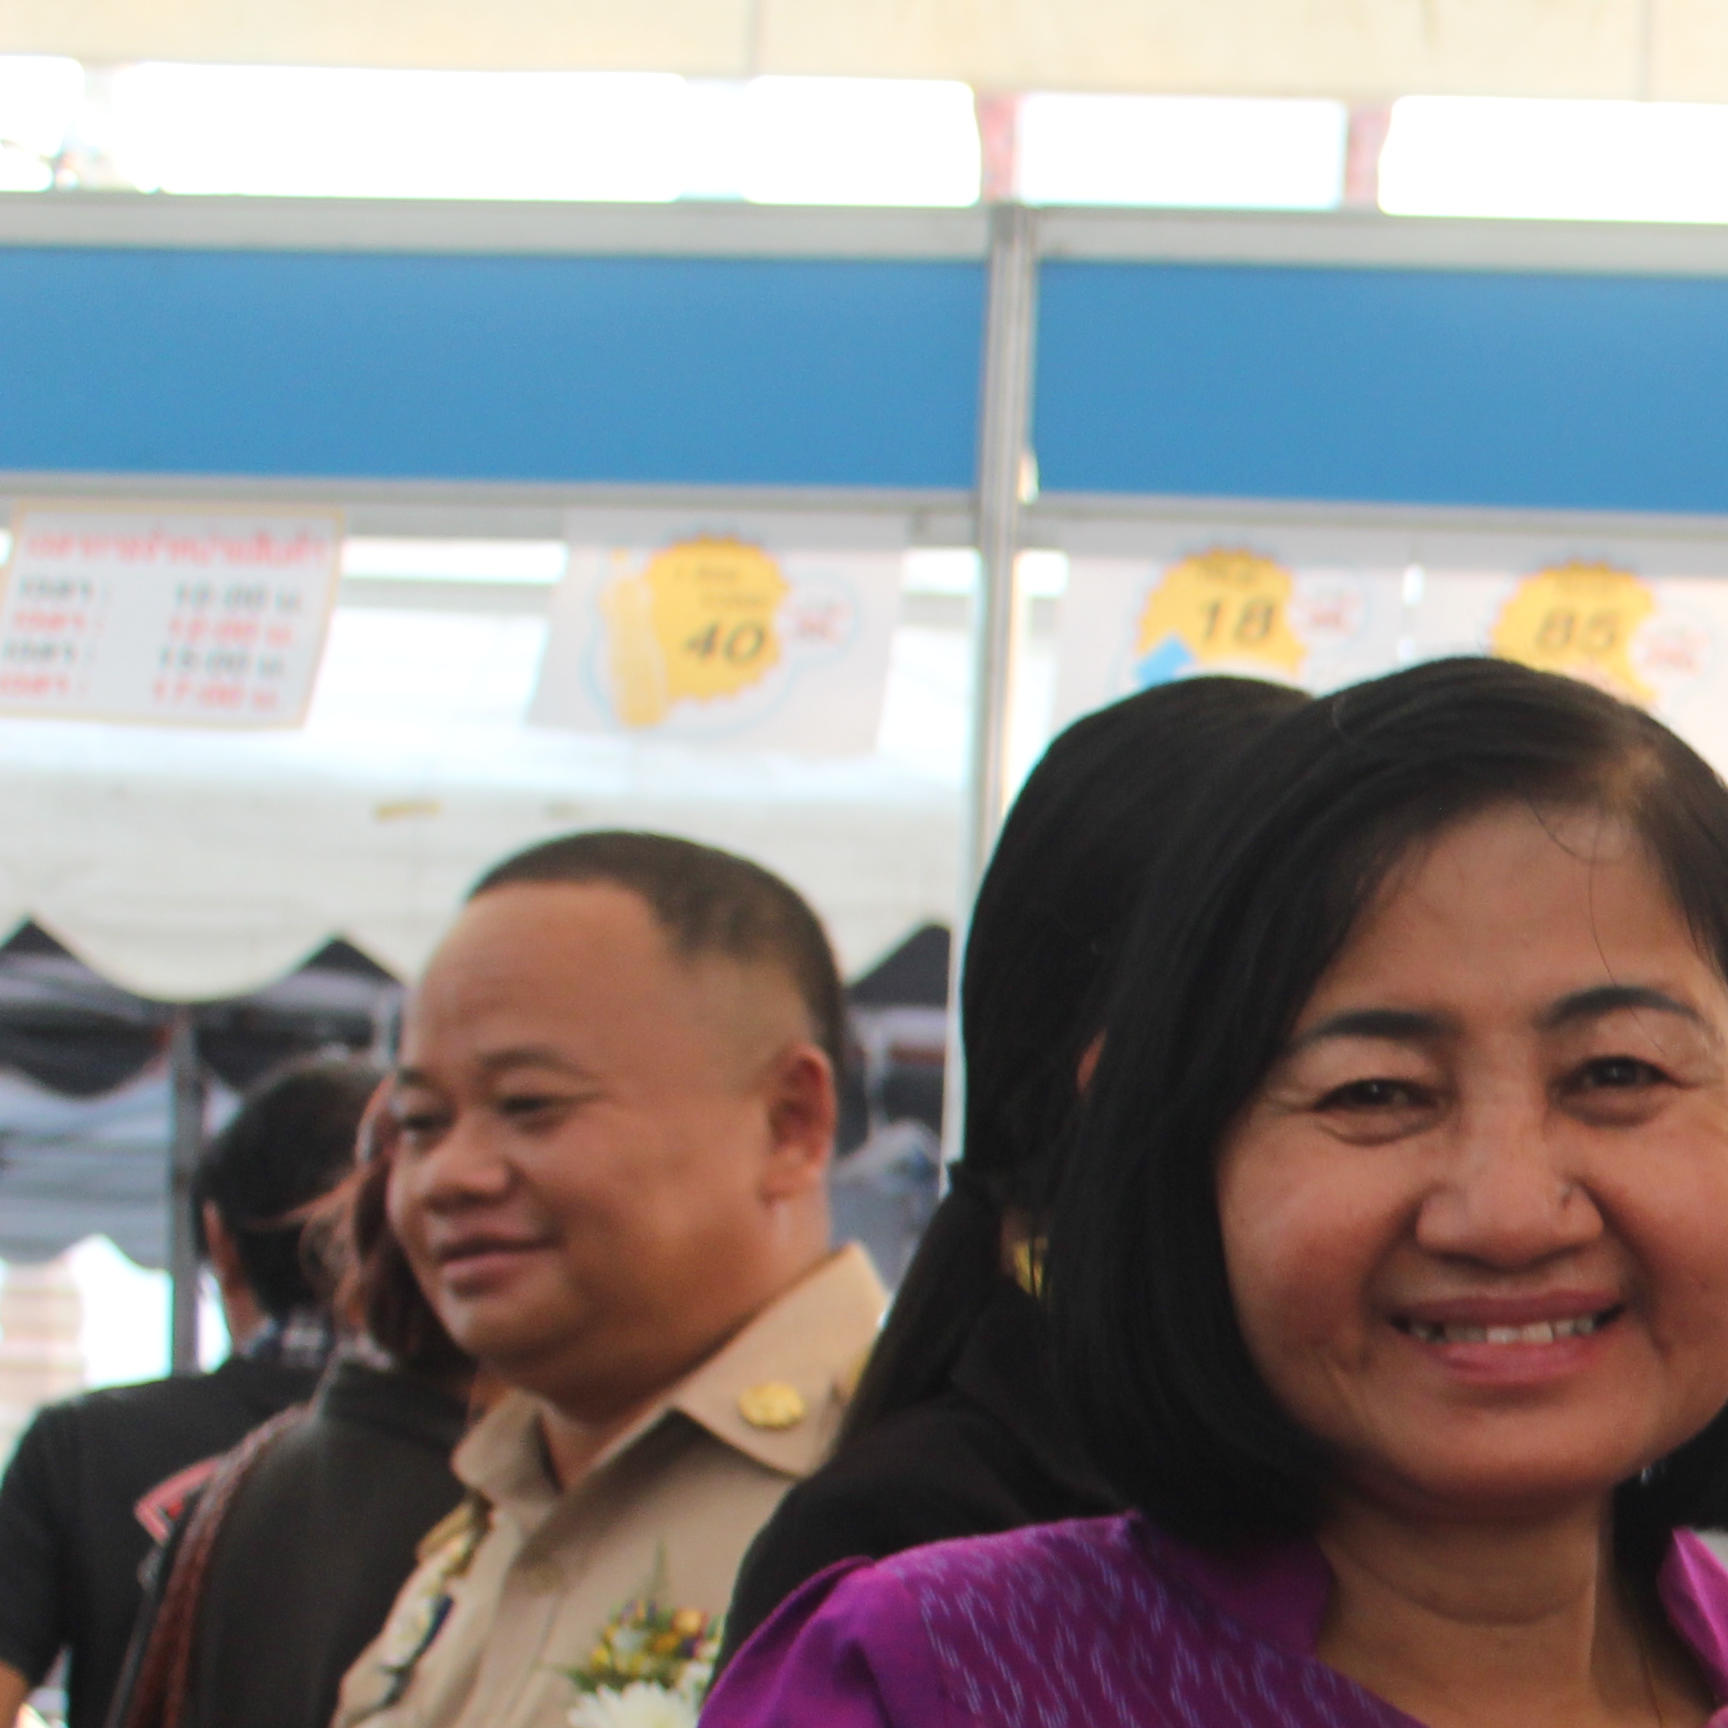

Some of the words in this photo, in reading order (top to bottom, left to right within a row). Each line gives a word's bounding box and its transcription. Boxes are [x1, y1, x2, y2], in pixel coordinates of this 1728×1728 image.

[682, 620, 766, 666] 40
[1199, 598, 1278, 647] 18
[1534, 608, 1622, 655] 85
